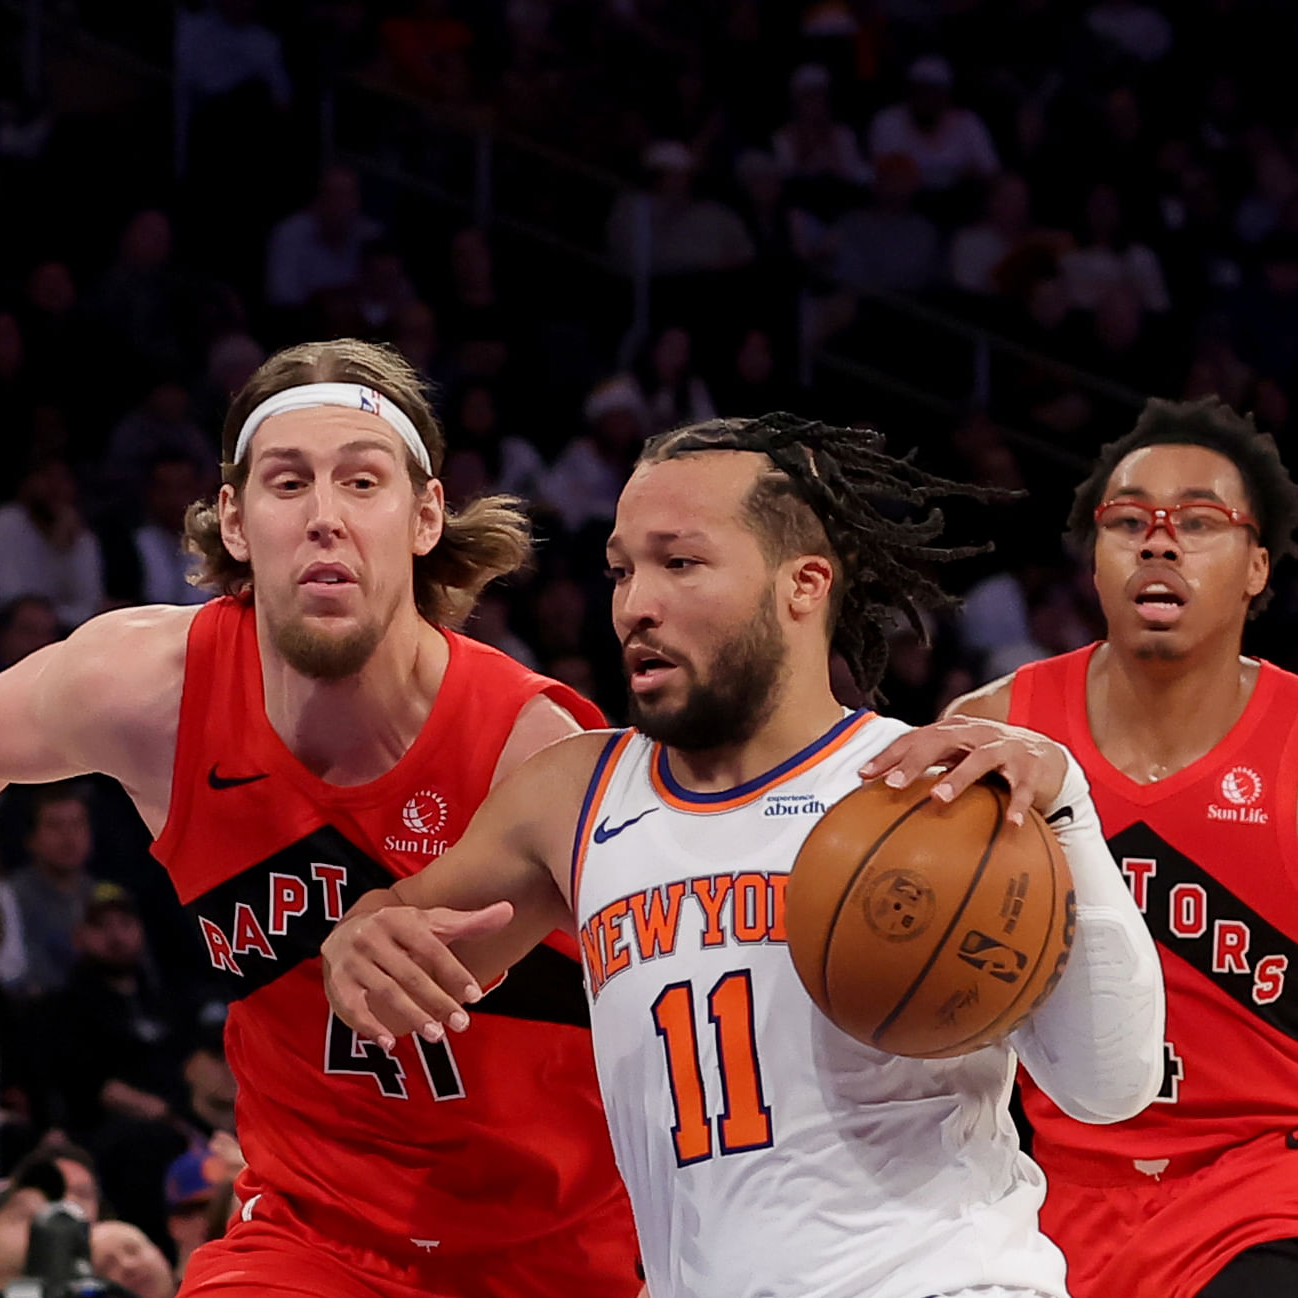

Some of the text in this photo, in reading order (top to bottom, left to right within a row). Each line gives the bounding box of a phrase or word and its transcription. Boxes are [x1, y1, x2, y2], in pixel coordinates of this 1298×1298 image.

[384, 835, 448, 855] Sun Lif
[764, 803, 799, 816] abu
[1207, 804, 1269, 824] Sun Life
[199, 863, 347, 977] RAPT
[580, 879, 687, 1005] NEW
[688, 870, 790, 951] YO
[1122, 857, 1289, 1006] TORS
[650, 967, 773, 1169] 11
